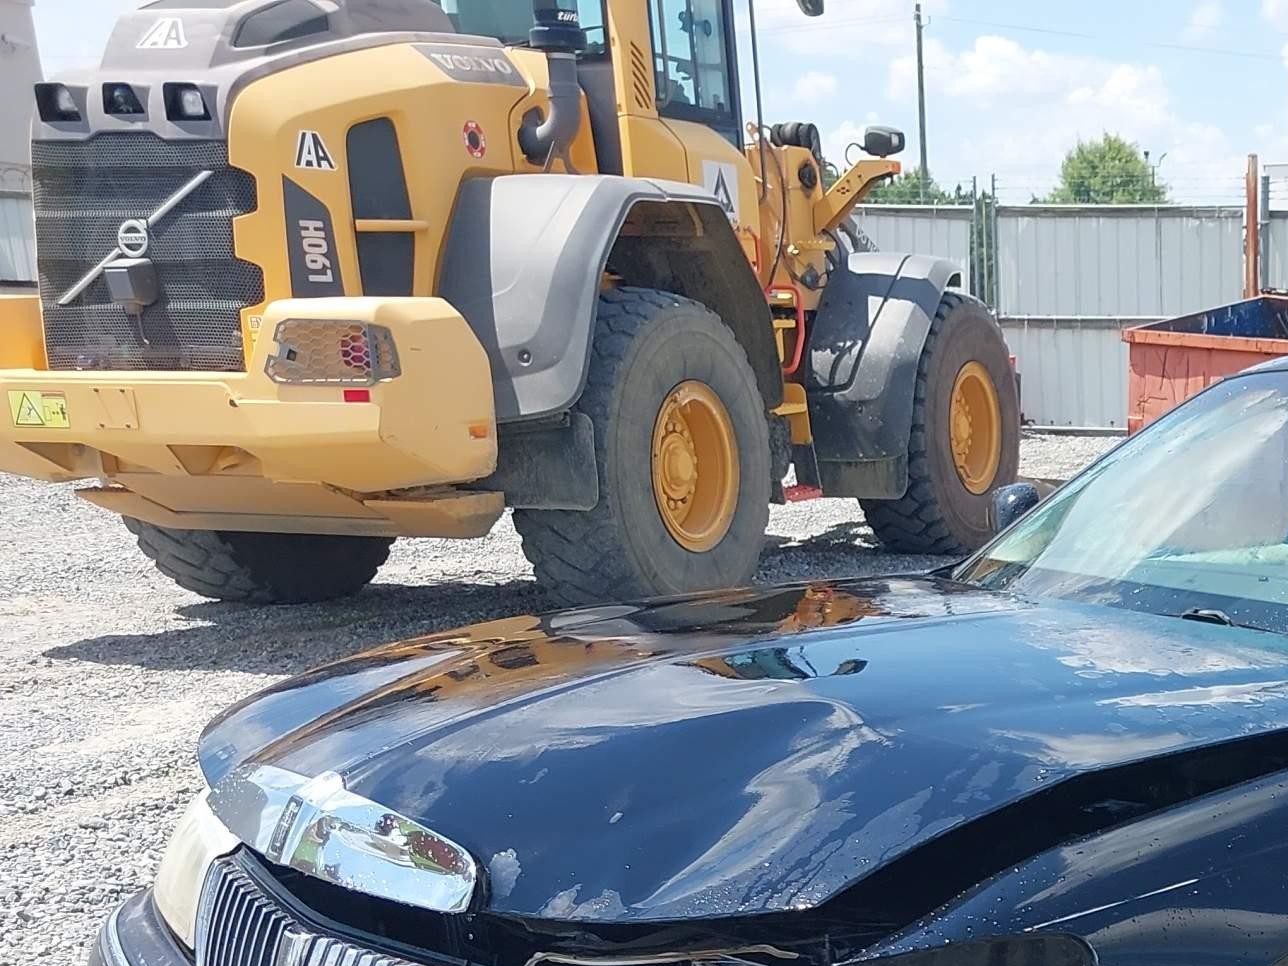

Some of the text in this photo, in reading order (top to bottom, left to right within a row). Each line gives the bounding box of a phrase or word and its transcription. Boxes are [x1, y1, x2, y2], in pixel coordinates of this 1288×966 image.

[430, 53, 512, 74] VOLVO
[296, 131, 335, 169] IAA
[298, 219, 334, 283] L90H
